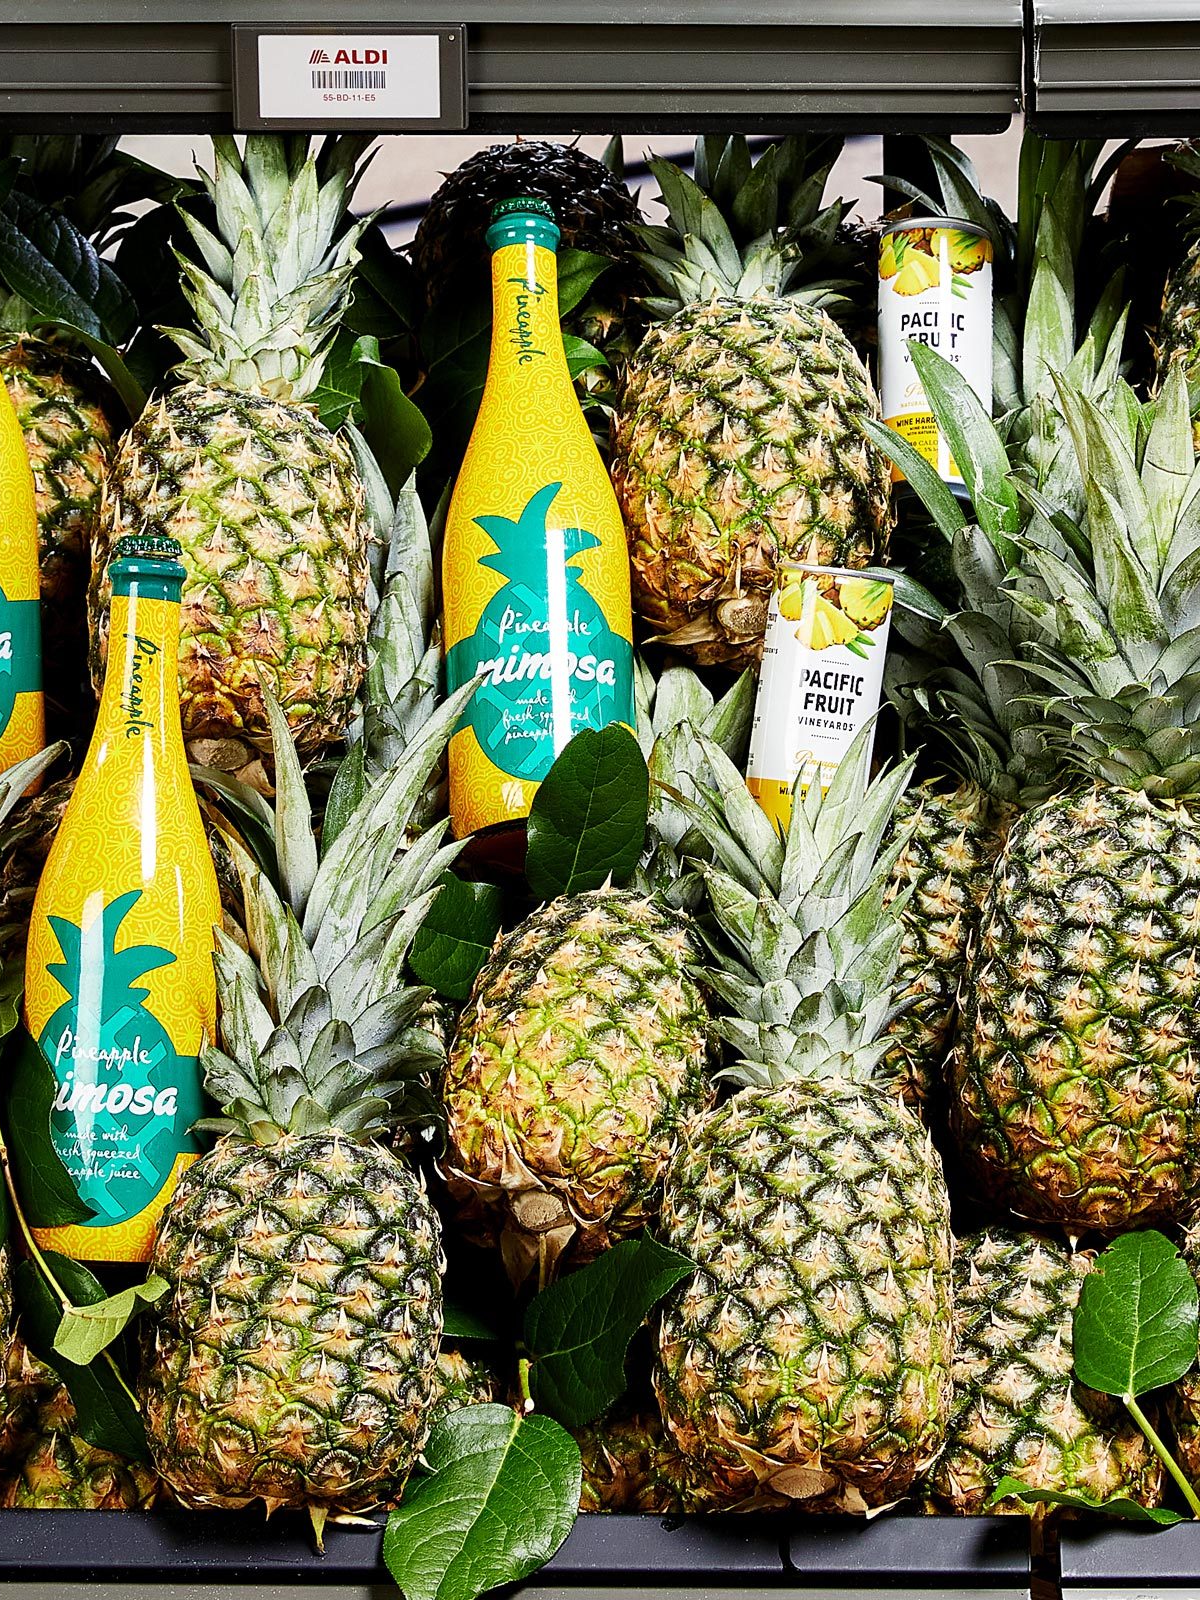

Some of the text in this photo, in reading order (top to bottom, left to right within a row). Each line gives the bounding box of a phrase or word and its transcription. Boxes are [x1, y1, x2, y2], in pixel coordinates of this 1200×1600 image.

[333, 49, 388, 64] ALDI
[506, 277, 549, 366] Pineapple
[901, 311, 965, 332] PACIIC
[896, 418, 913, 428] WINE
[498, 603, 592, 645] Pineale
[475, 643, 617, 688] mimosa
[120, 632, 162, 740] Pineapple
[798, 668, 864, 697] PACIFIC
[514, 688, 550, 707] made
[803, 692, 855, 716] FRUIT
[504, 721, 554, 745] pineappl
[797, 716, 855, 732] VINEYARDS
[54, 1024, 153, 1072] Pineapple
[54, 1070, 178, 1116] imosa
[63, 1123, 129, 1144] made with
[67, 1161, 142, 1184] eapple juice
